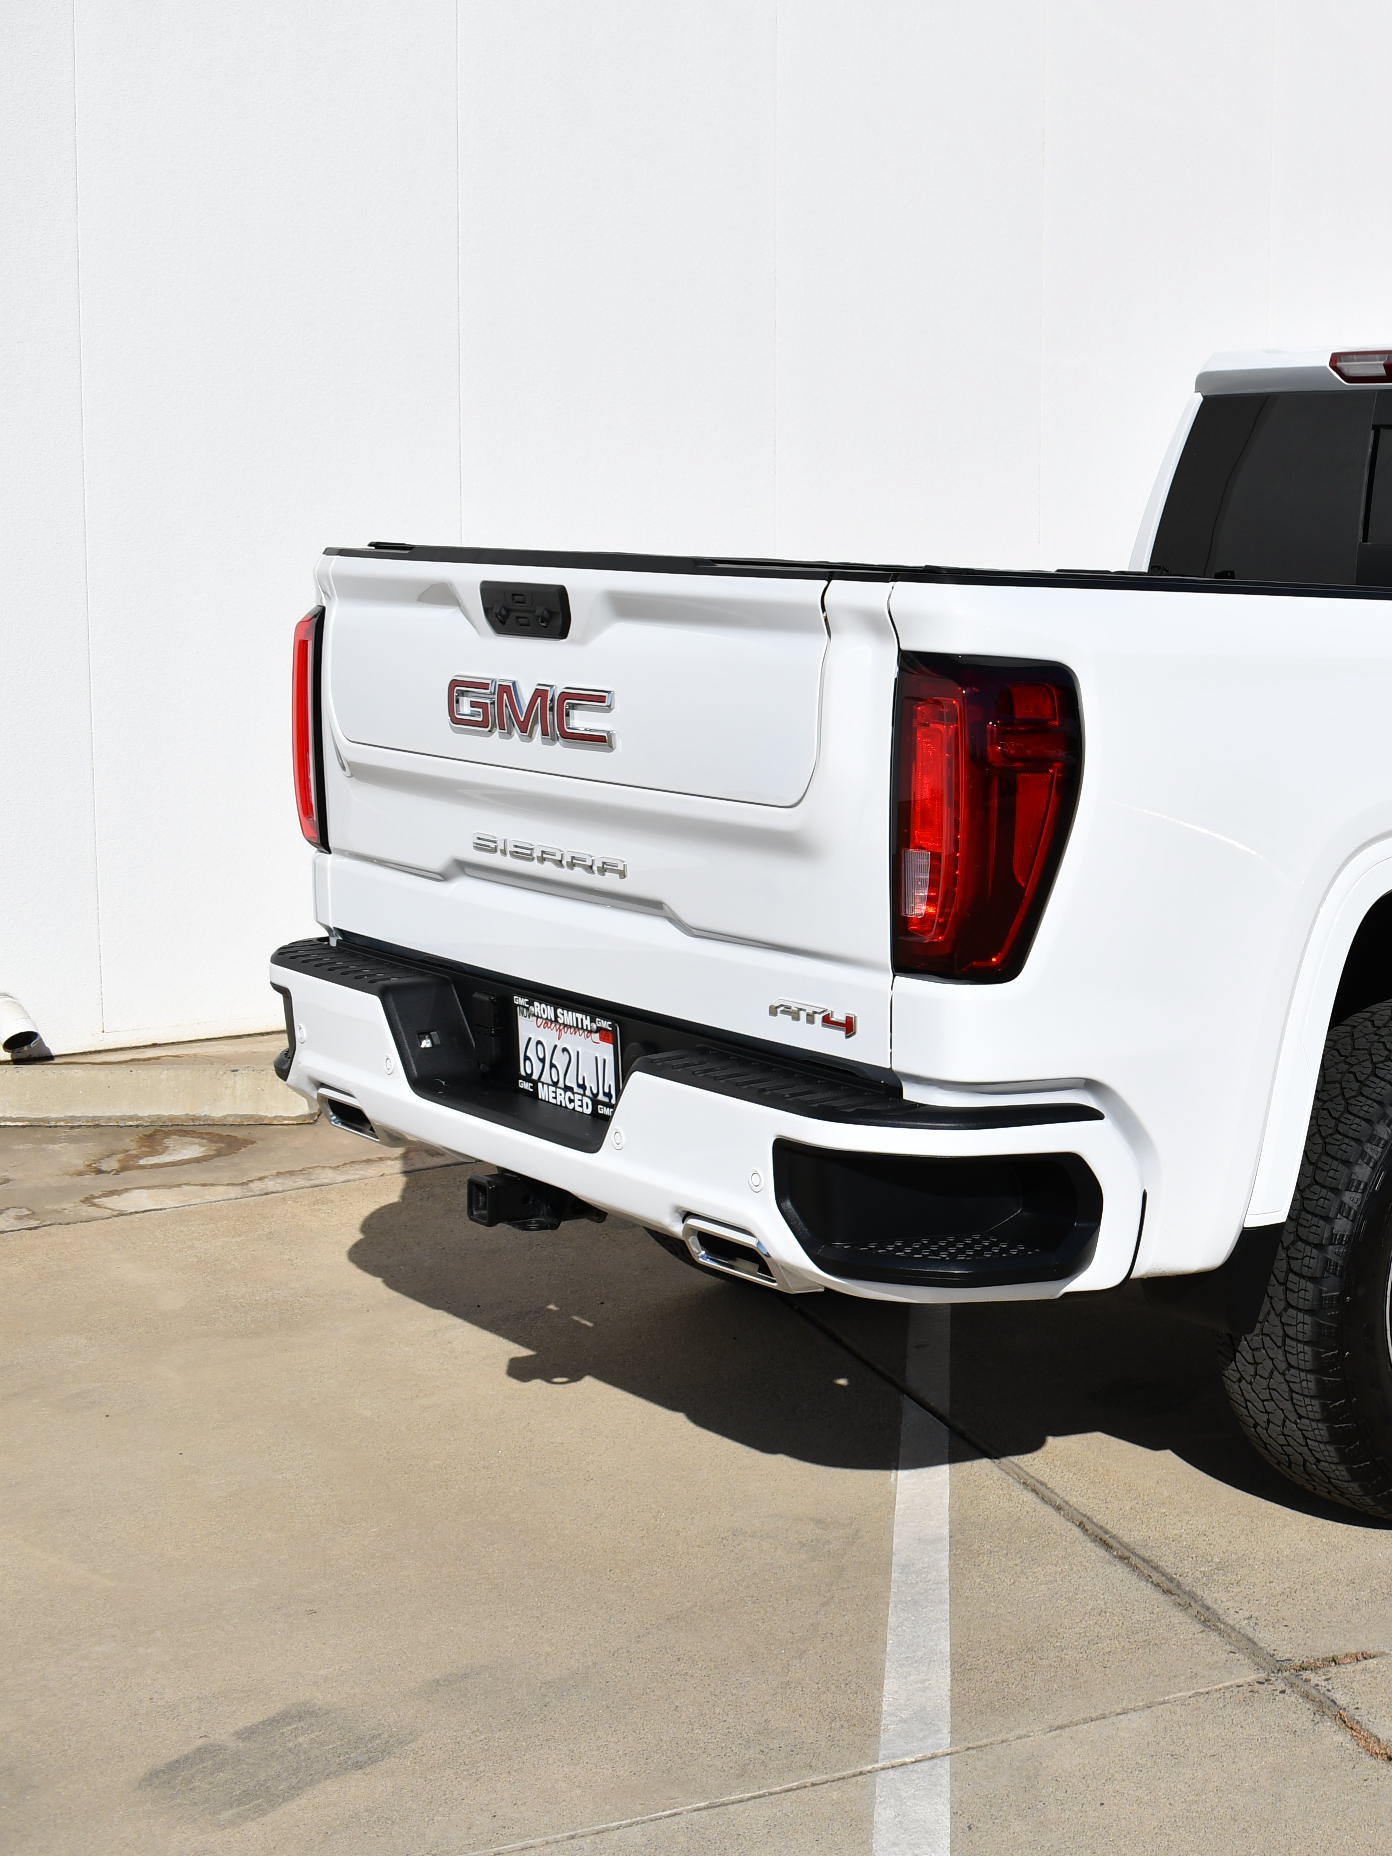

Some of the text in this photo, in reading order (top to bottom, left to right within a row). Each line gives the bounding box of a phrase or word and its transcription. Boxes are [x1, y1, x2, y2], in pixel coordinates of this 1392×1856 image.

[447, 674, 617, 753] GMC
[472, 831, 630, 879] SIERRA
[513, 995, 530, 1008] GMC
[533, 1001, 591, 1031] RON SMITH
[595, 1018, 613, 1031] GMC
[768, 998, 857, 1040] AT4
[518, 1079, 534, 1092] GMC
[522, 1036, 614, 1103] 69624J4
[537, 1082, 593, 1115] MERCED
